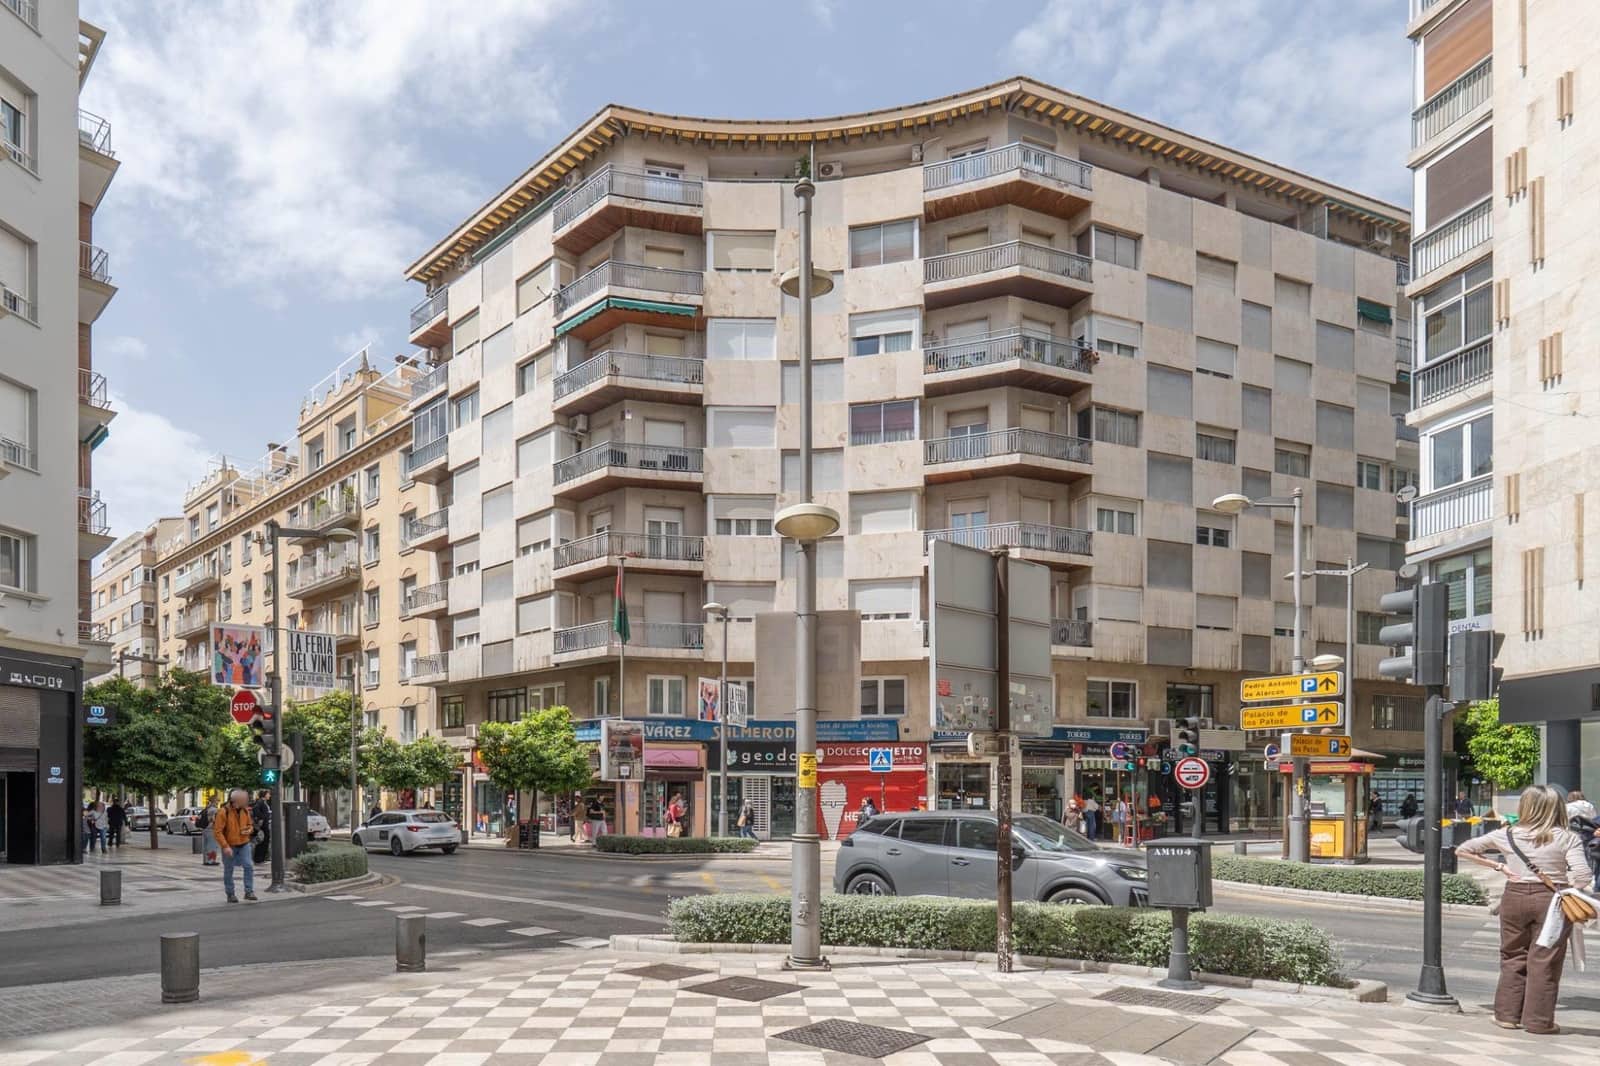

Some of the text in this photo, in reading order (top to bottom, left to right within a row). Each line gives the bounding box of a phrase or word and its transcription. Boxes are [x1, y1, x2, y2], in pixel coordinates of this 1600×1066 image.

[1452, 622, 1480, 632] DENTAL
[290, 633, 333, 655] LA FERIA
[291, 653, 333, 673] DEL VINO
[1304, 680, 1316, 691] P
[234, 702, 254, 711] STOP
[1304, 710, 1315, 721] P
[643, 726, 692, 738] VAREZ
[828, 746, 922, 756] DOLCECETTO
[1154, 848, 1192, 856] AM104
